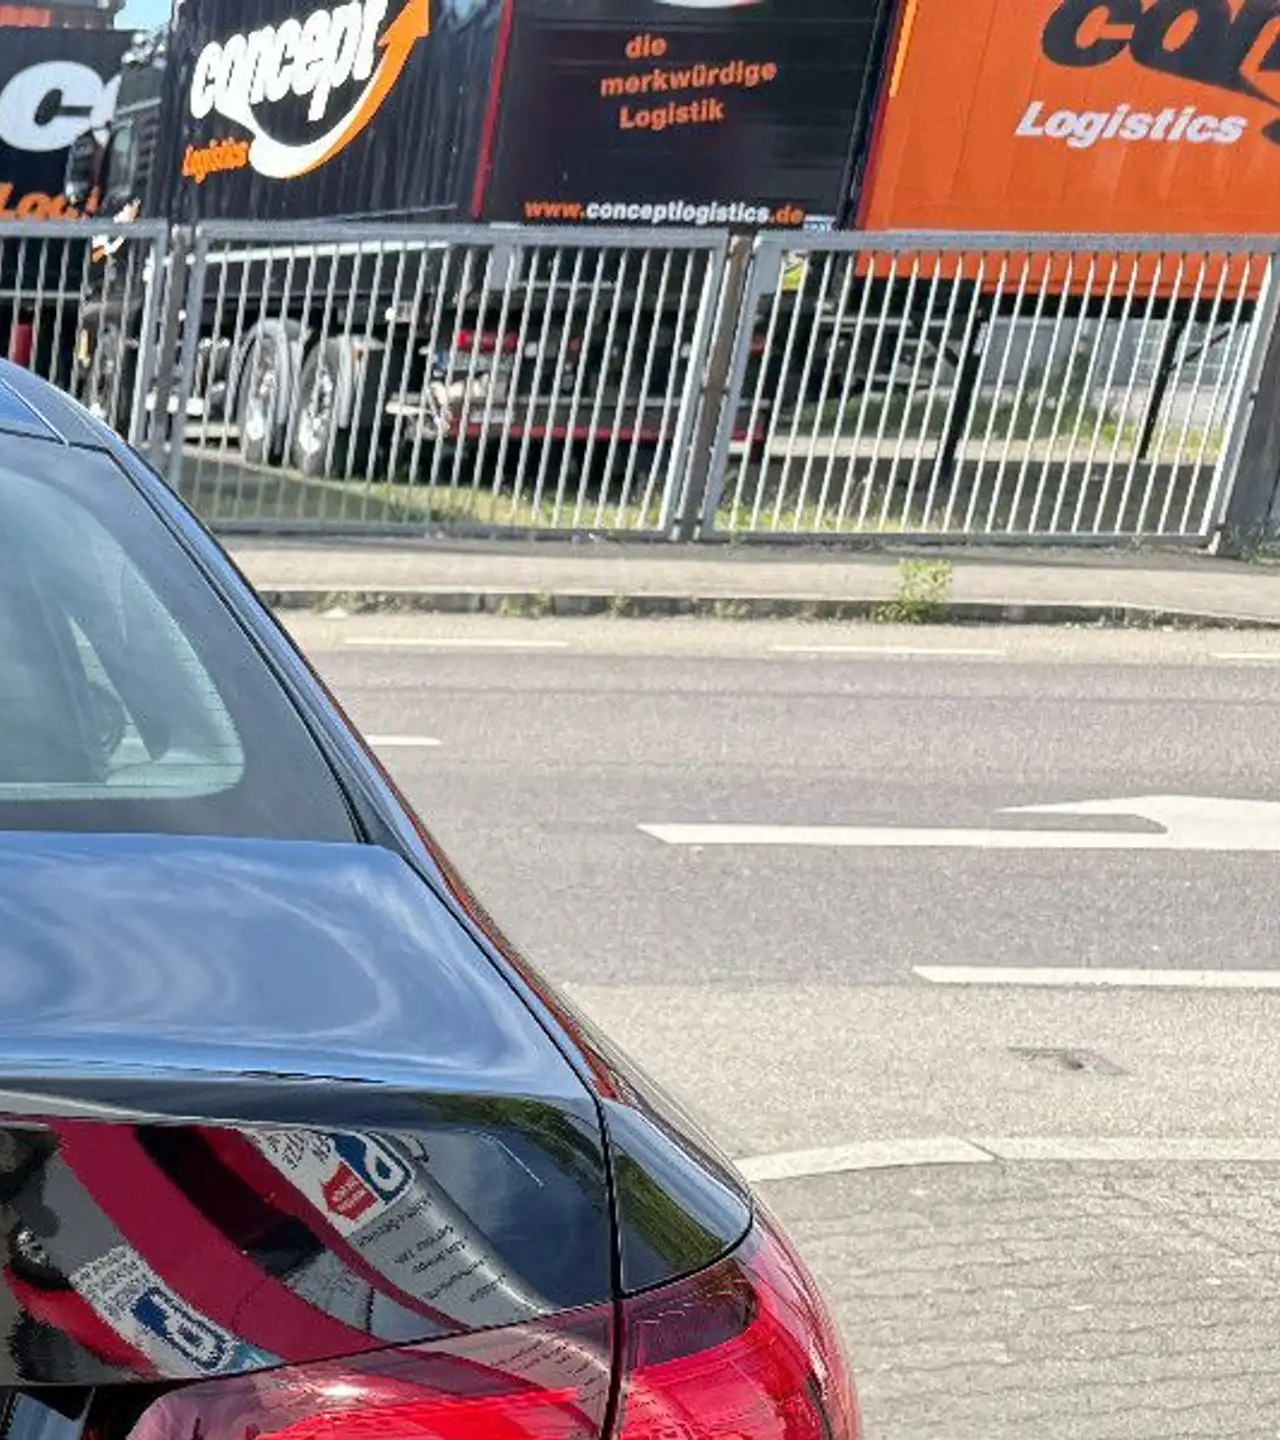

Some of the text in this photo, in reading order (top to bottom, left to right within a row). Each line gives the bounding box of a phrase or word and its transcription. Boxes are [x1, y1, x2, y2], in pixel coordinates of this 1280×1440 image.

[625, 34, 668, 58] die
[600, 60, 778, 97] merkwürdige
[619, 99, 725, 131] Logistik
[1015, 100, 1248, 149] Logistics
[525, 200, 806, 225] www.conceptlogistics.de
